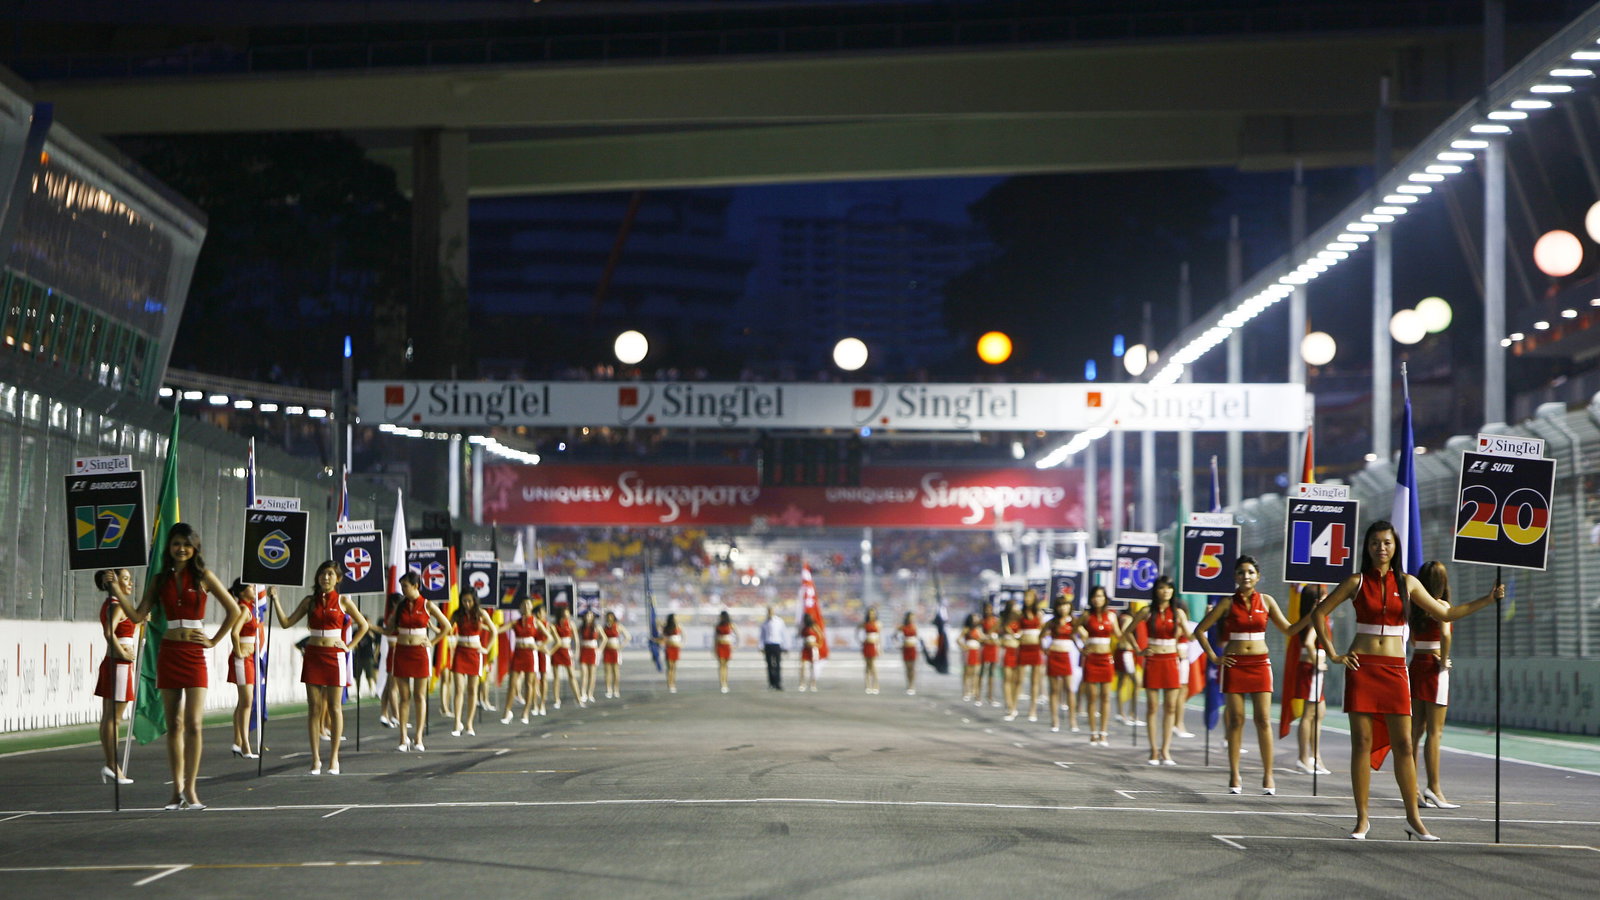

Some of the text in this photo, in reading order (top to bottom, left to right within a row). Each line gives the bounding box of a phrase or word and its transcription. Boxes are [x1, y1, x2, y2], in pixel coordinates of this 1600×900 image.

[428, 383, 1251, 430] SingTel SingTel SingTel SingTel
[90, 458, 129, 471] SingTel
[1495, 440, 1540, 455] SingTel
[90, 480, 138, 490] BARRICHELLO
[1491, 462, 1515, 473] SUTIL
[267, 499, 298, 510] SingTel
[522, 486, 614, 504] UNIQUELY
[617, 470, 760, 523] Singapore
[921, 472, 1066, 525] Singapore
[1312, 487, 1347, 498] SingTel
[75, 504, 136, 551] 17
[1456, 484, 1549, 546] 20
[257, 529, 292, 569] 6
[1290, 520, 1350, 566] 14
[344, 547, 372, 582] 9
[1117, 556, 1158, 591] 10
[1195, 542, 1225, 580] 5
